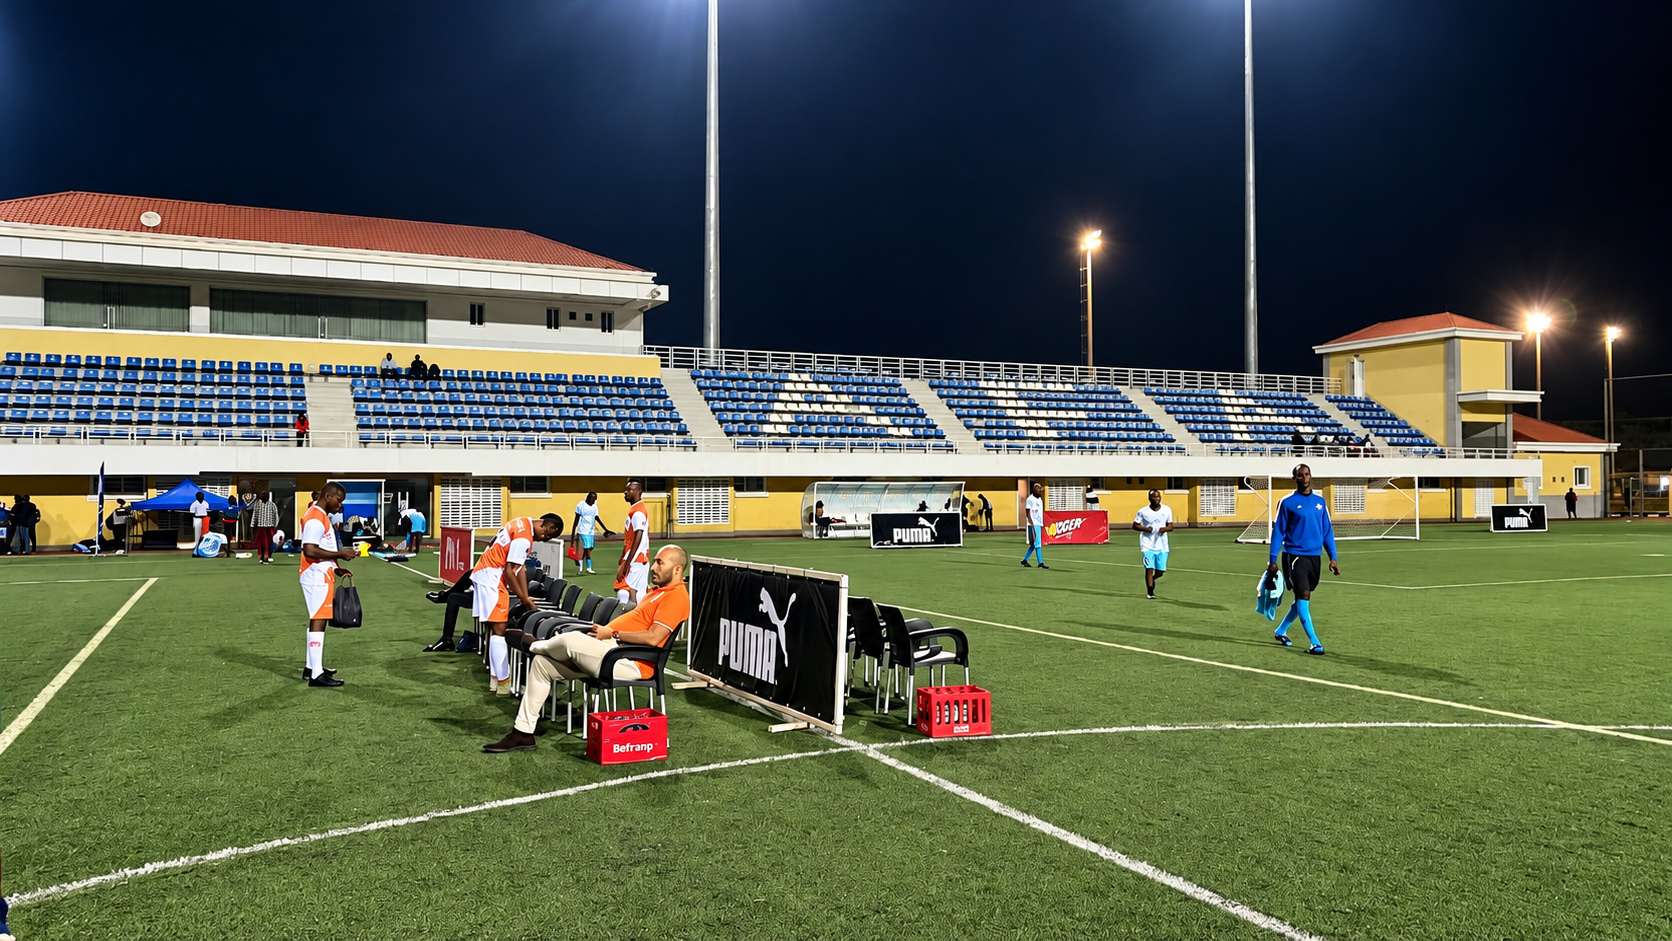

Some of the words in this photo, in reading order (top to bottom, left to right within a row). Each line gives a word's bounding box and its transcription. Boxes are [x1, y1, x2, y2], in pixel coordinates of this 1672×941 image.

[1504, 517, 1528, 528] PUMA
[893, 528, 932, 543] PUMA
[718, 617, 778, 685] PUMA
[613, 742, 653, 754] Befranp
